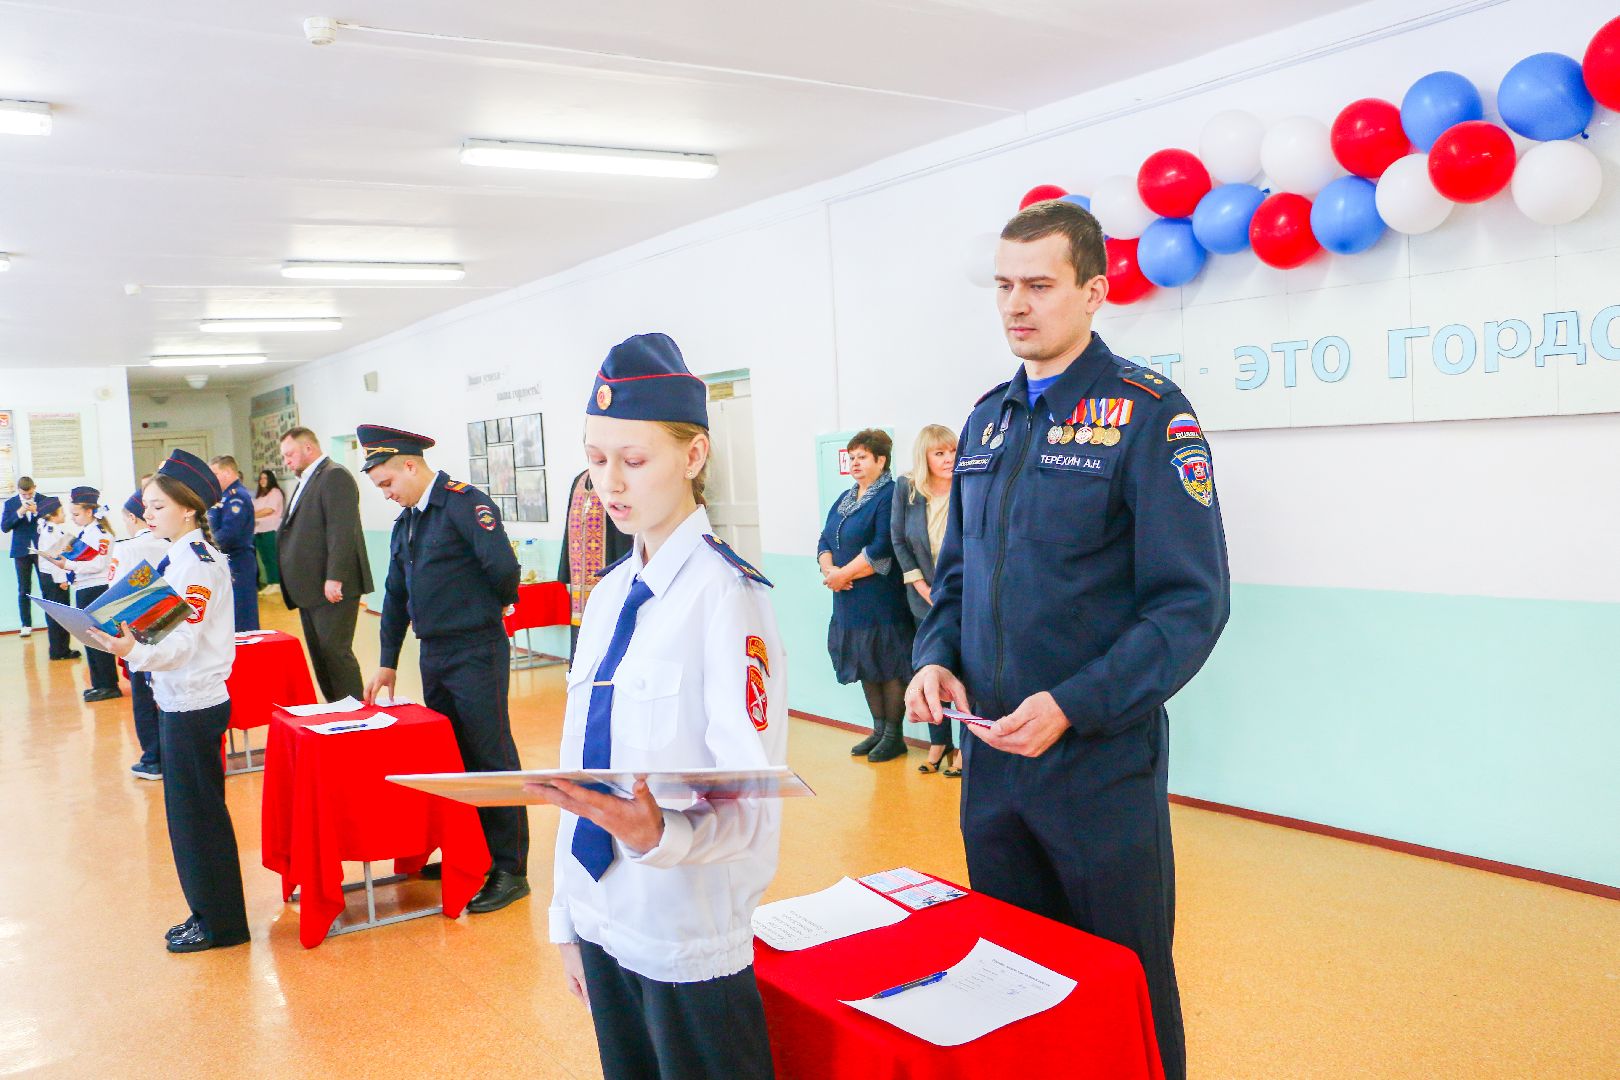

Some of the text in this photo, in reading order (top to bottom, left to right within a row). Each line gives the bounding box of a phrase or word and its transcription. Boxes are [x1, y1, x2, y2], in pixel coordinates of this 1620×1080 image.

[1234, 335, 1351, 391] ЭТО
[1040, 454, 1101, 469] ТЕРЁХИН А.Н.
